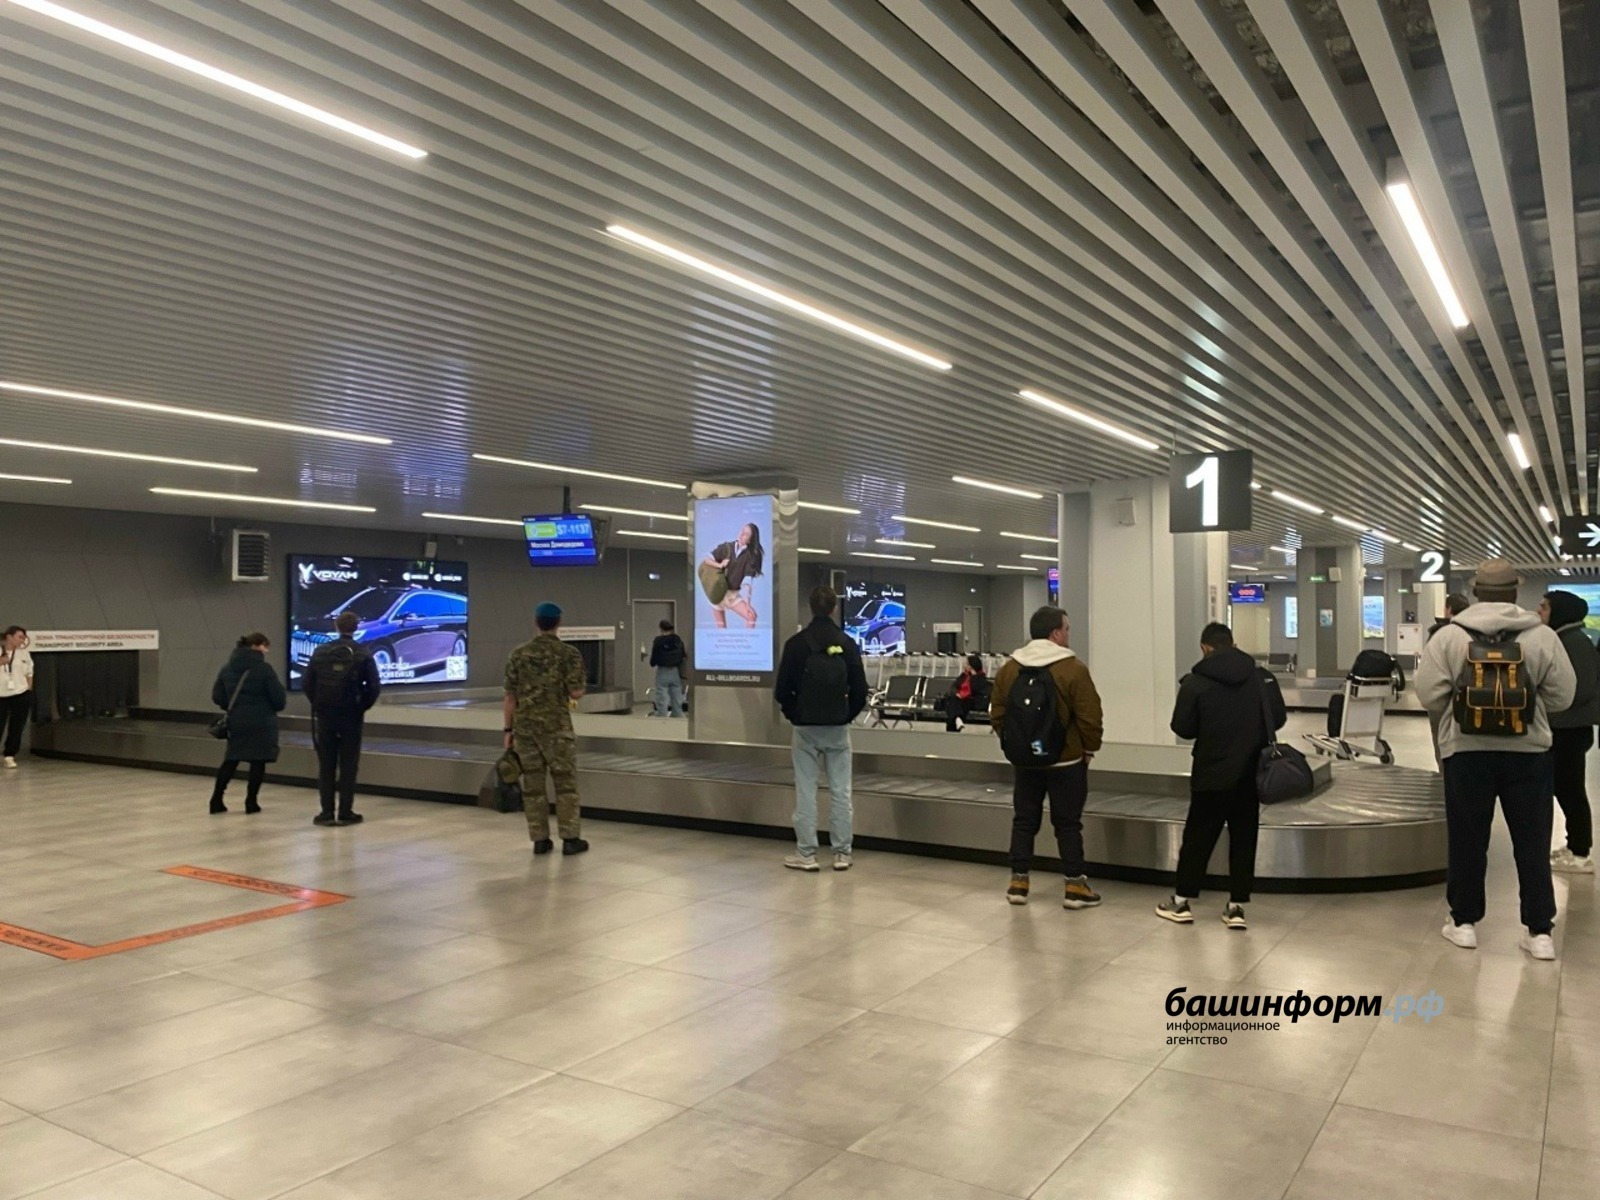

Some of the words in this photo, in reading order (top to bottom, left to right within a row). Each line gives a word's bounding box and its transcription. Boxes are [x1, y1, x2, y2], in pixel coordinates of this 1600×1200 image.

[1186, 456, 1219, 527] 1
[557, 523, 590, 535] S7-1137
[1421, 551, 1444, 582] 2
